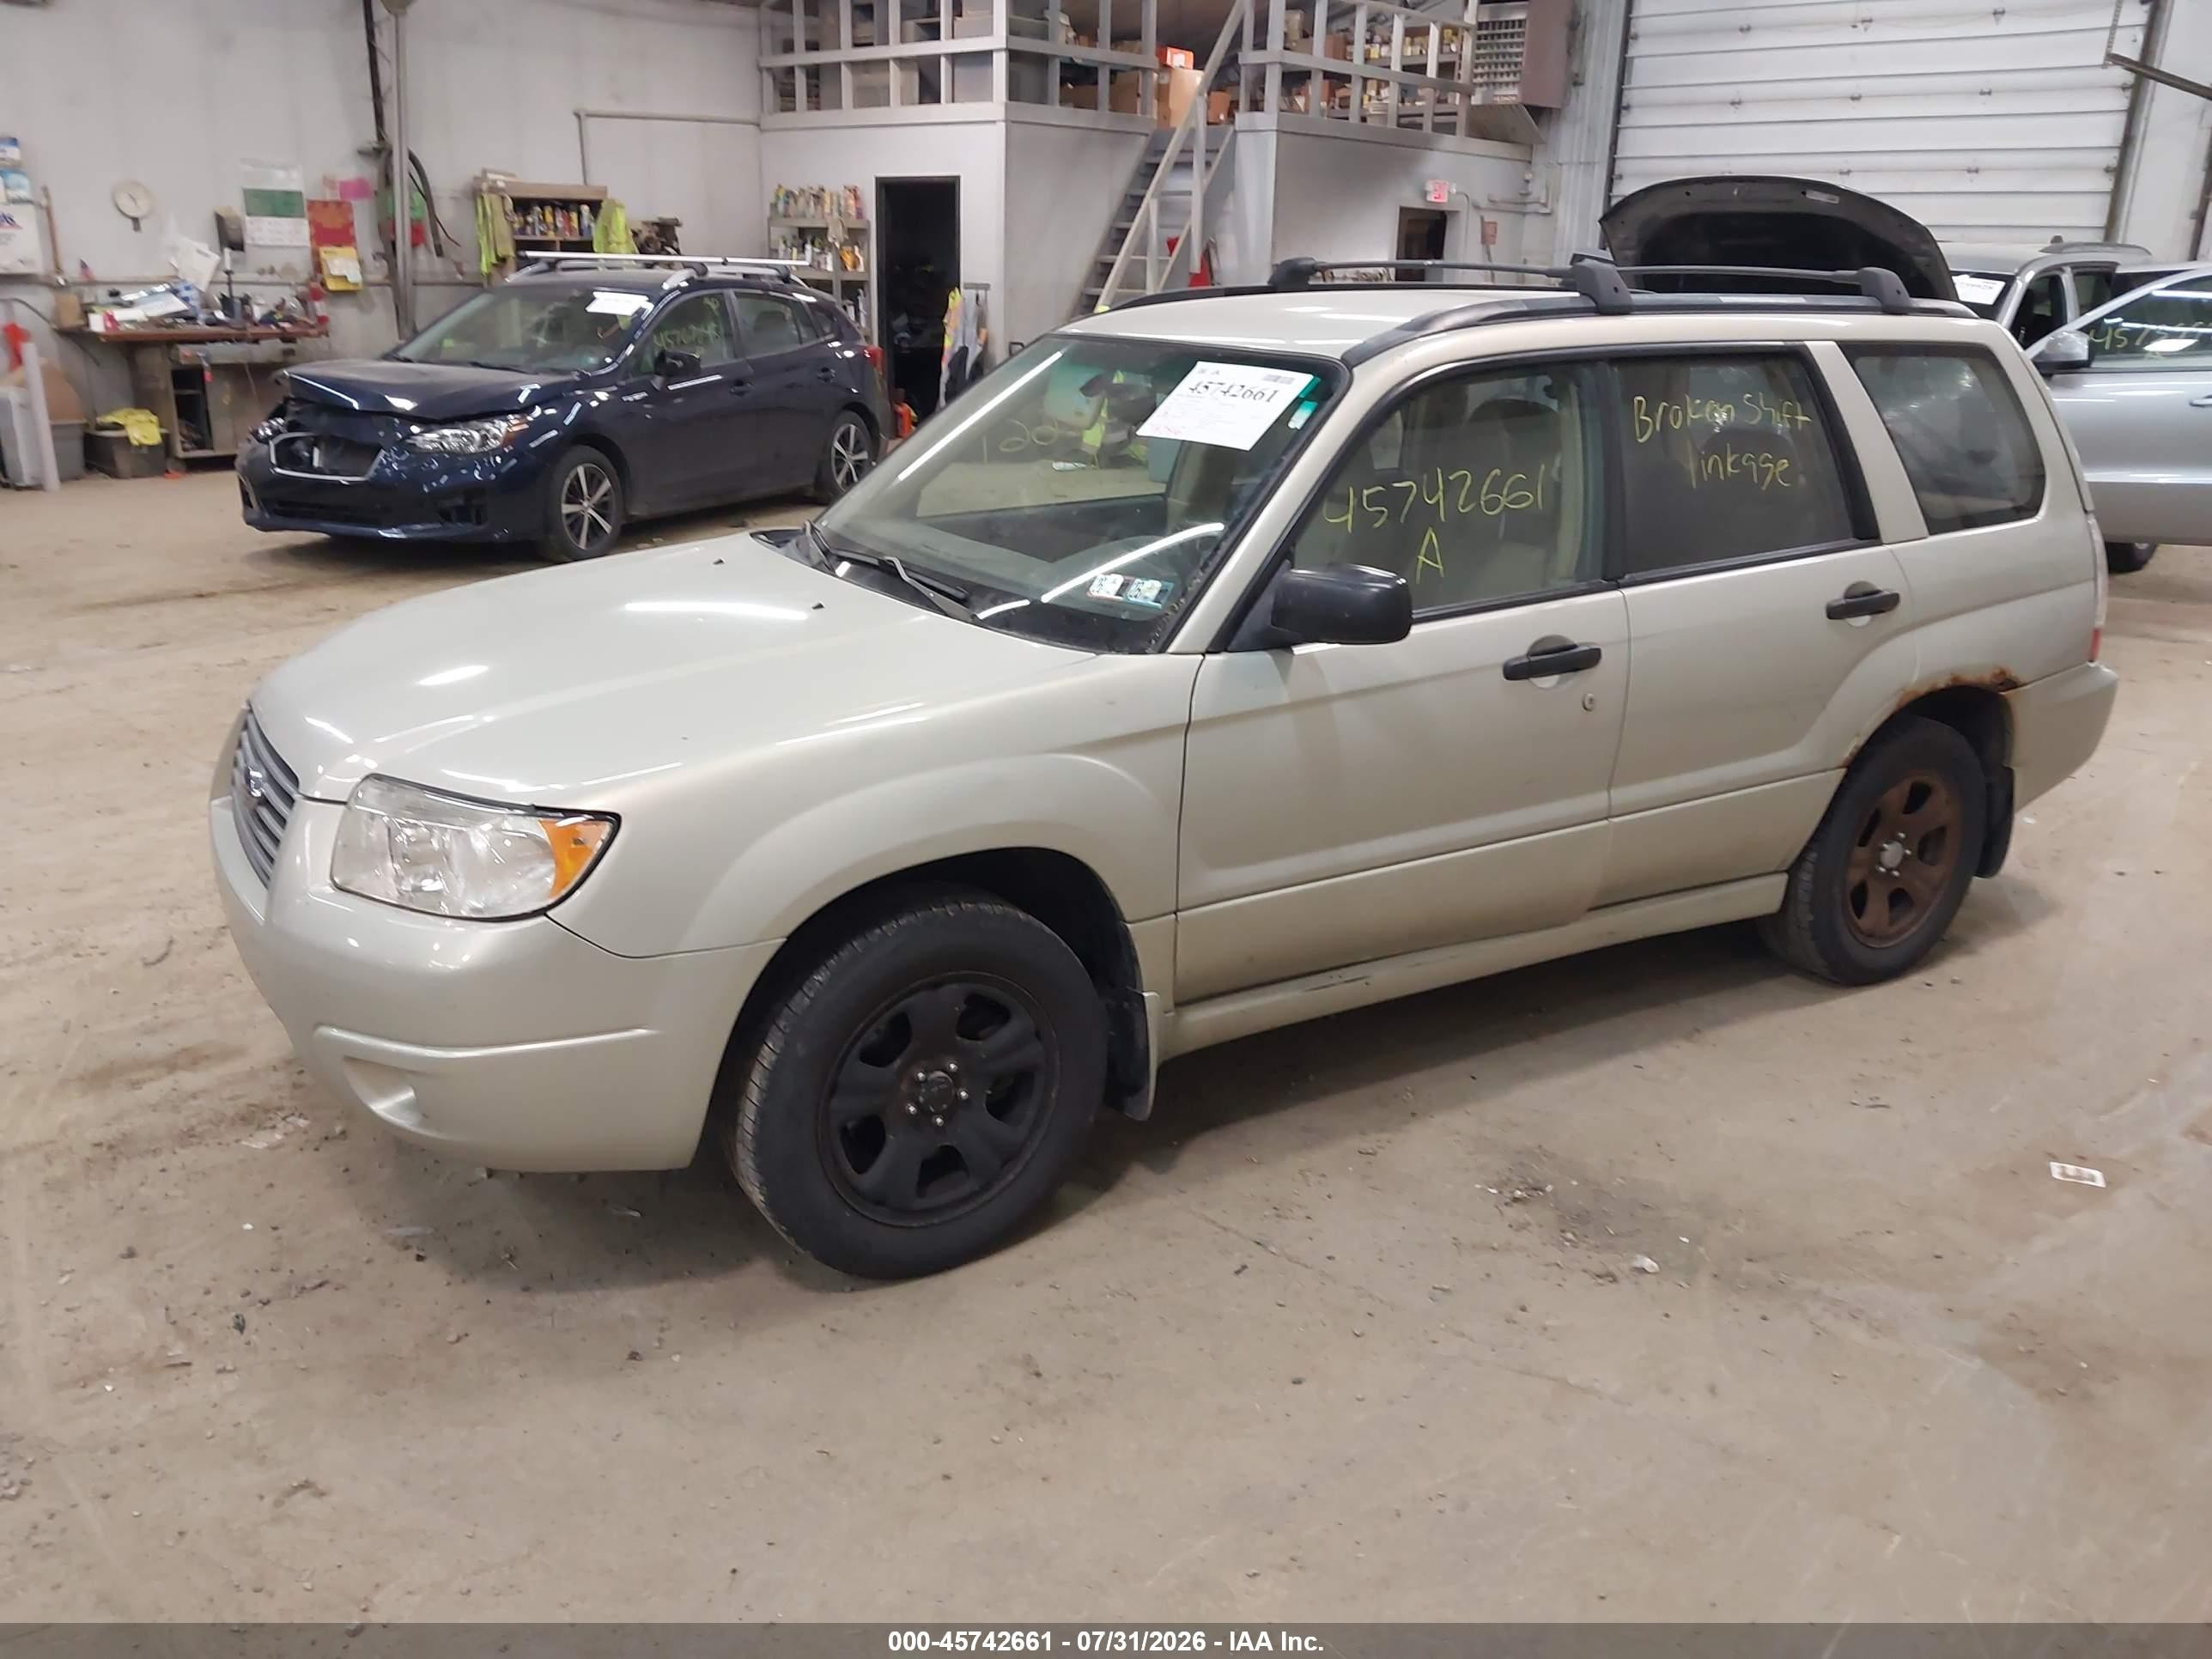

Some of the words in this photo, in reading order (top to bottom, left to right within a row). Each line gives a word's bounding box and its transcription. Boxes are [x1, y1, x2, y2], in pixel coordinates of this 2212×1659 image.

[1188, 380, 1280, 403] 45742661
[1322, 464, 1545, 533] 45742661
[1416, 526, 1444, 585] A
